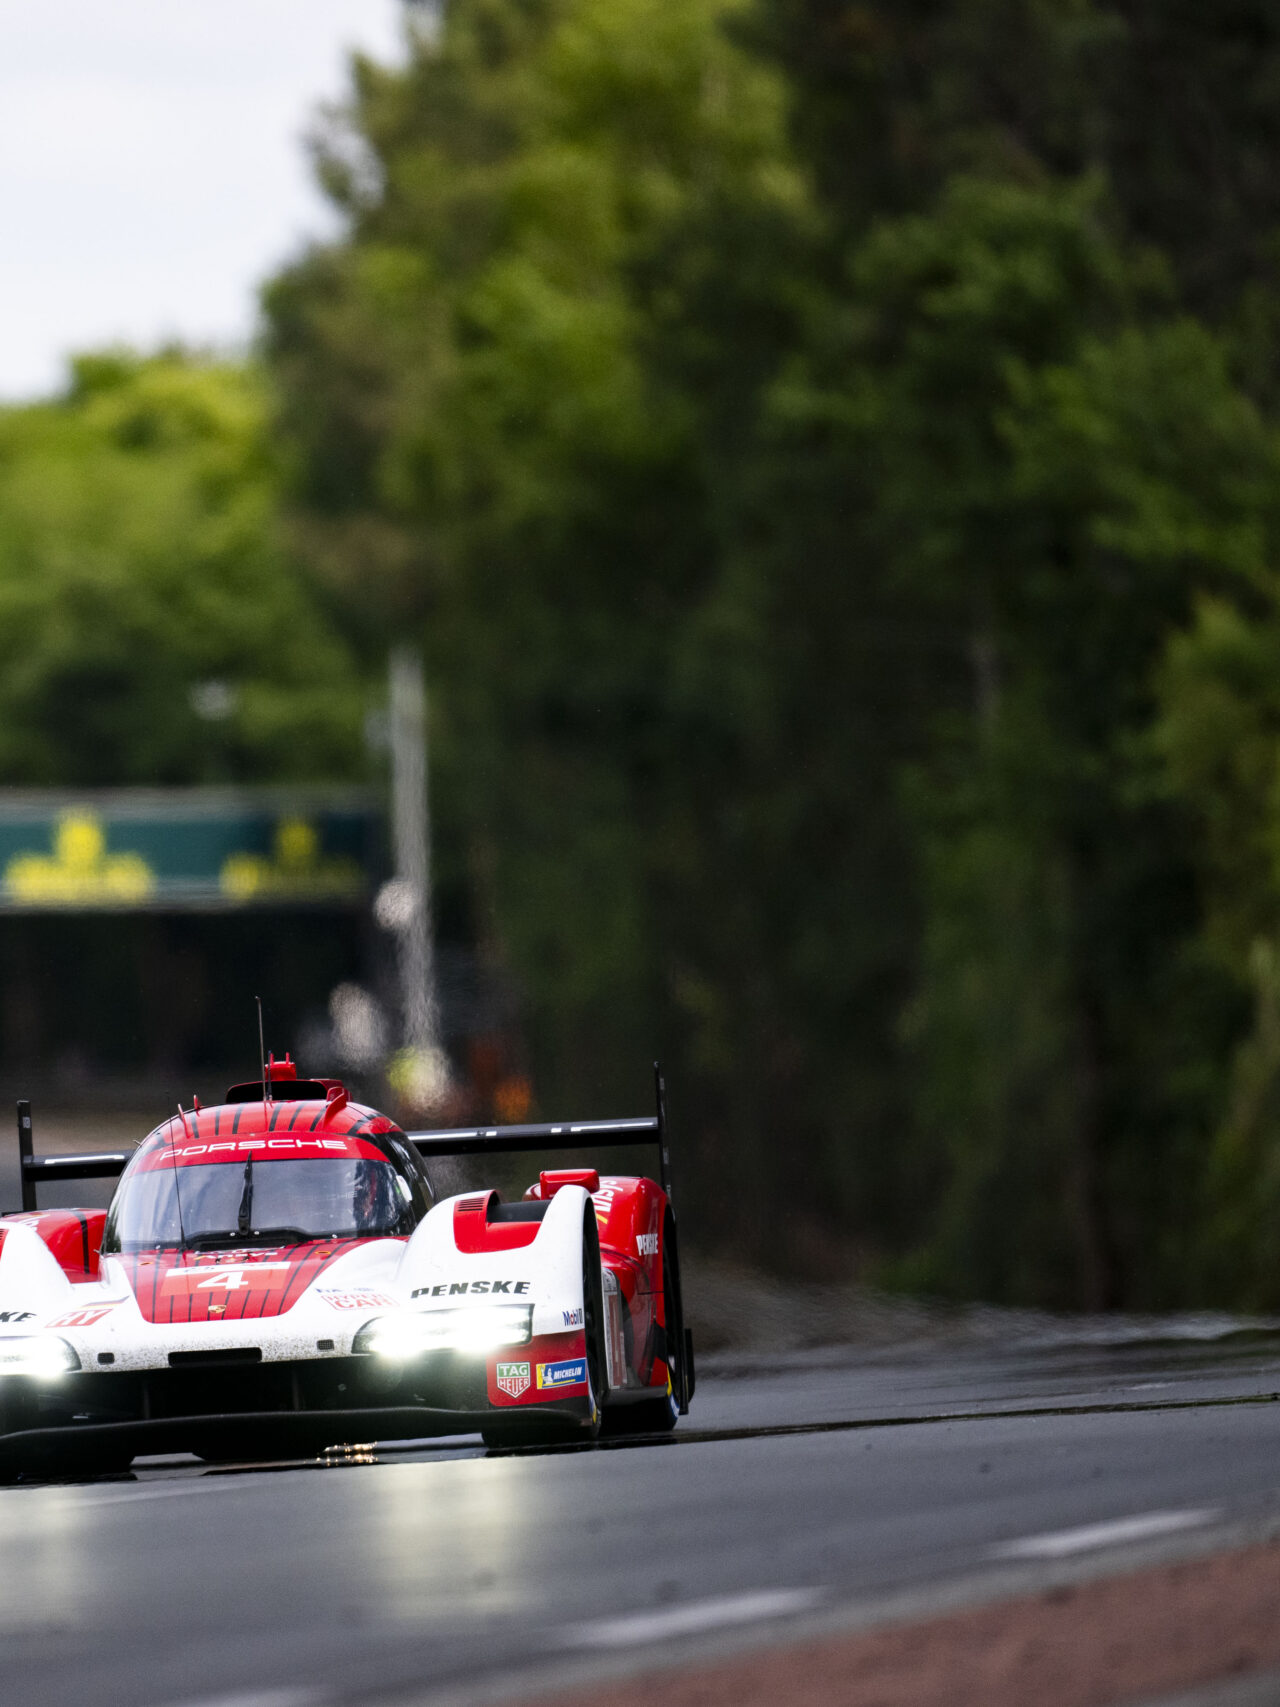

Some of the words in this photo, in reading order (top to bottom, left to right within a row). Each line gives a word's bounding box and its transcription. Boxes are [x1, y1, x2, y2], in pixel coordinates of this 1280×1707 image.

[159, 1138, 348, 1161] PORSCHE
[197, 1270, 249, 1290] 4
[410, 1280, 531, 1299] PENSKE
[499, 1365, 528, 1376] TAG
[553, 1366, 583, 1380] MICHELIN
[499, 1377, 529, 1396] HEUER
